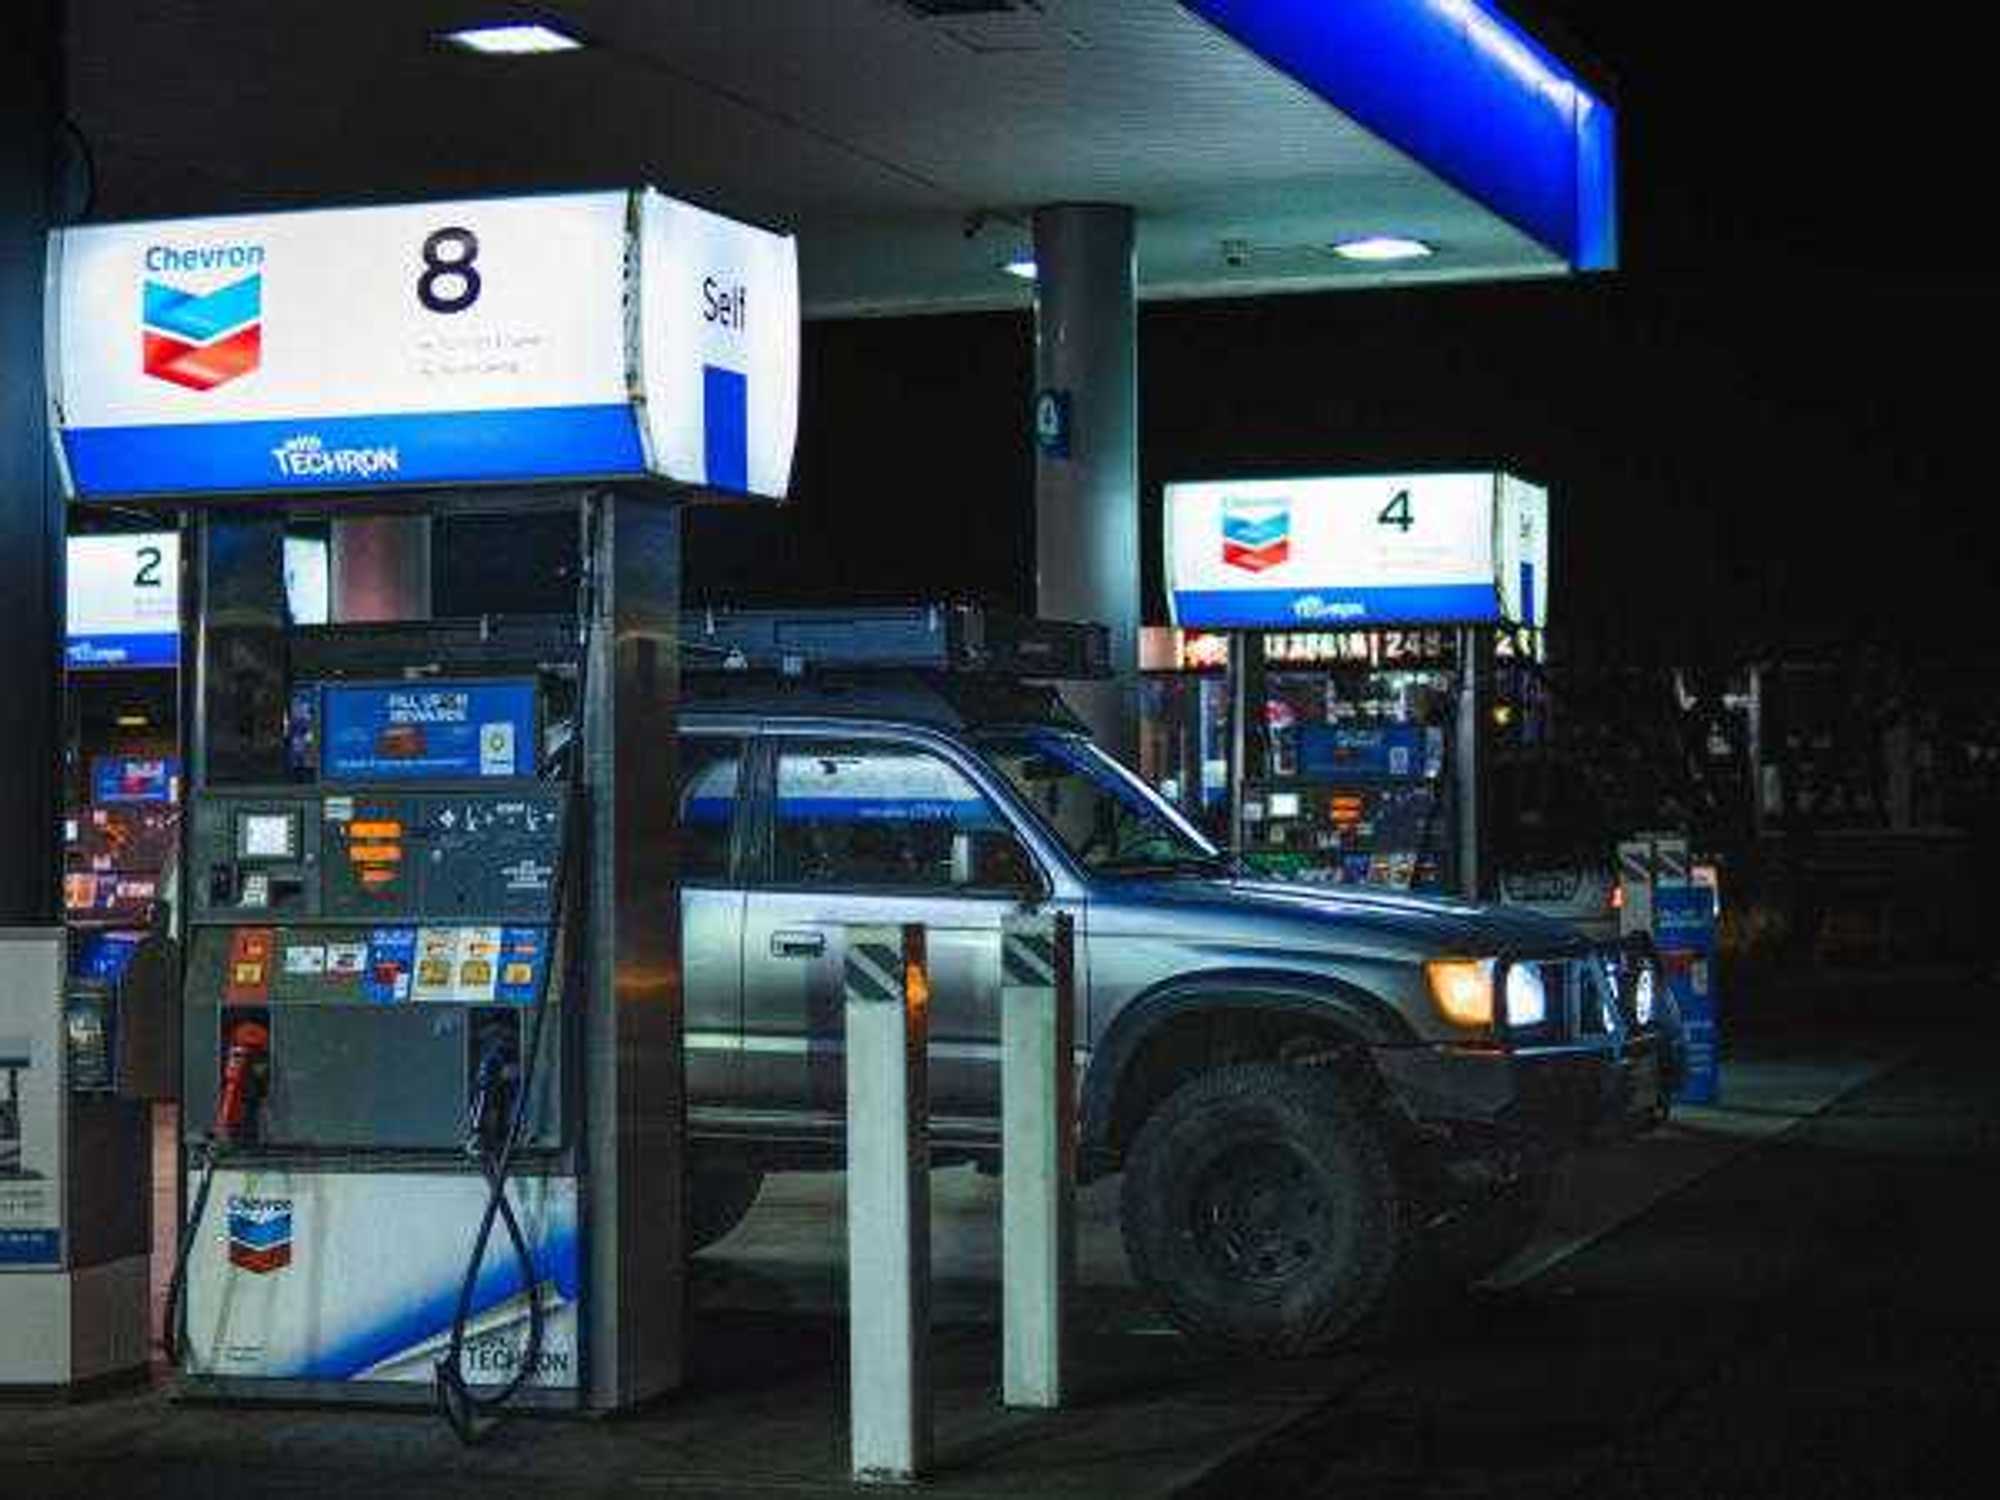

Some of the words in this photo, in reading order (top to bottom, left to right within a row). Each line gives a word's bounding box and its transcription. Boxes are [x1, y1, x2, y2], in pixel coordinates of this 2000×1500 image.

[146, 243, 264, 271] Chevron
[417, 226, 482, 314] 8
[703, 276, 746, 332] Self
[271, 446, 400, 478] TECHRON
[1377, 489, 1415, 532] 4
[133, 546, 162, 587] 2
